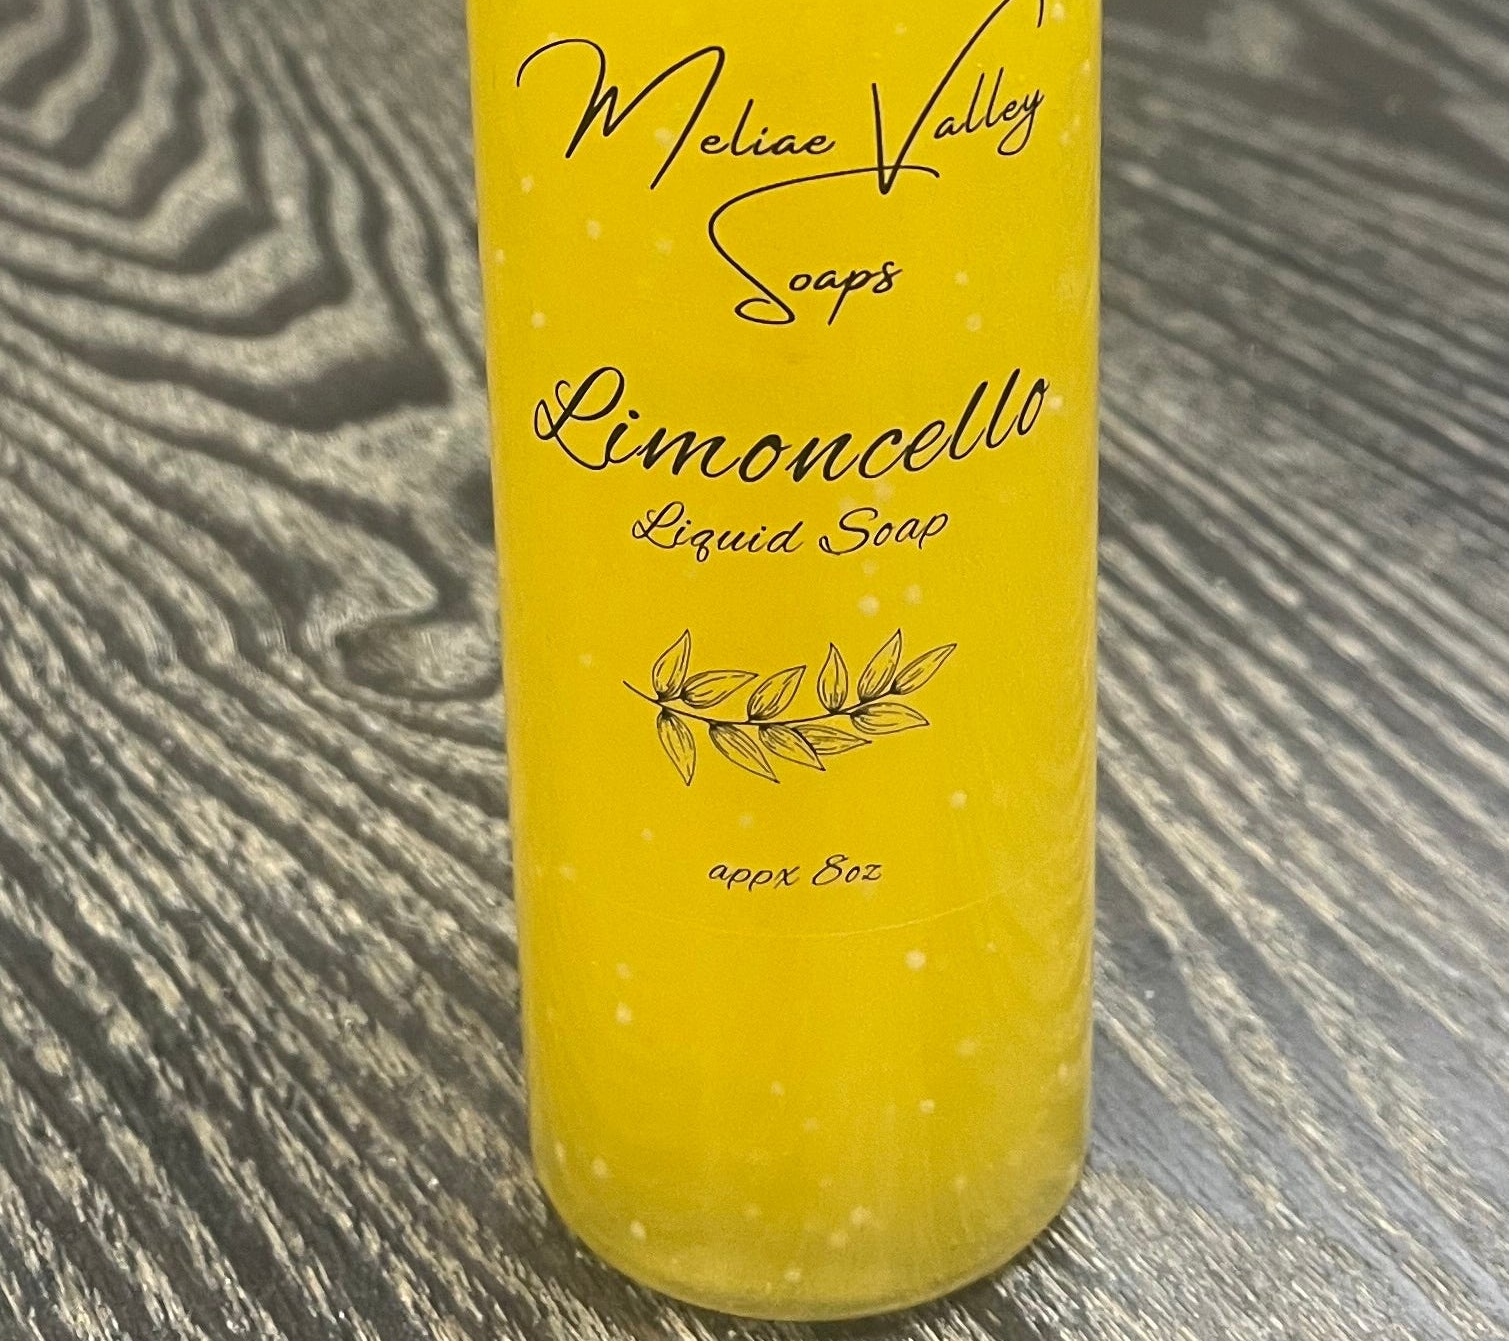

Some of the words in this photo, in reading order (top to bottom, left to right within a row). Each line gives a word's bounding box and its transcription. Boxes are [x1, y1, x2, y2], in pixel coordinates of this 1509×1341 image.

[516, 38, 836, 190] Meliae
[707, 164, 941, 326] Soaps
[533, 366, 1051, 483] Limoncello
[631, 500, 805, 563] Liquid
[818, 506, 949, 556] Soap
[707, 864, 800, 892] appx
[811, 854, 883, 886] 8oz
